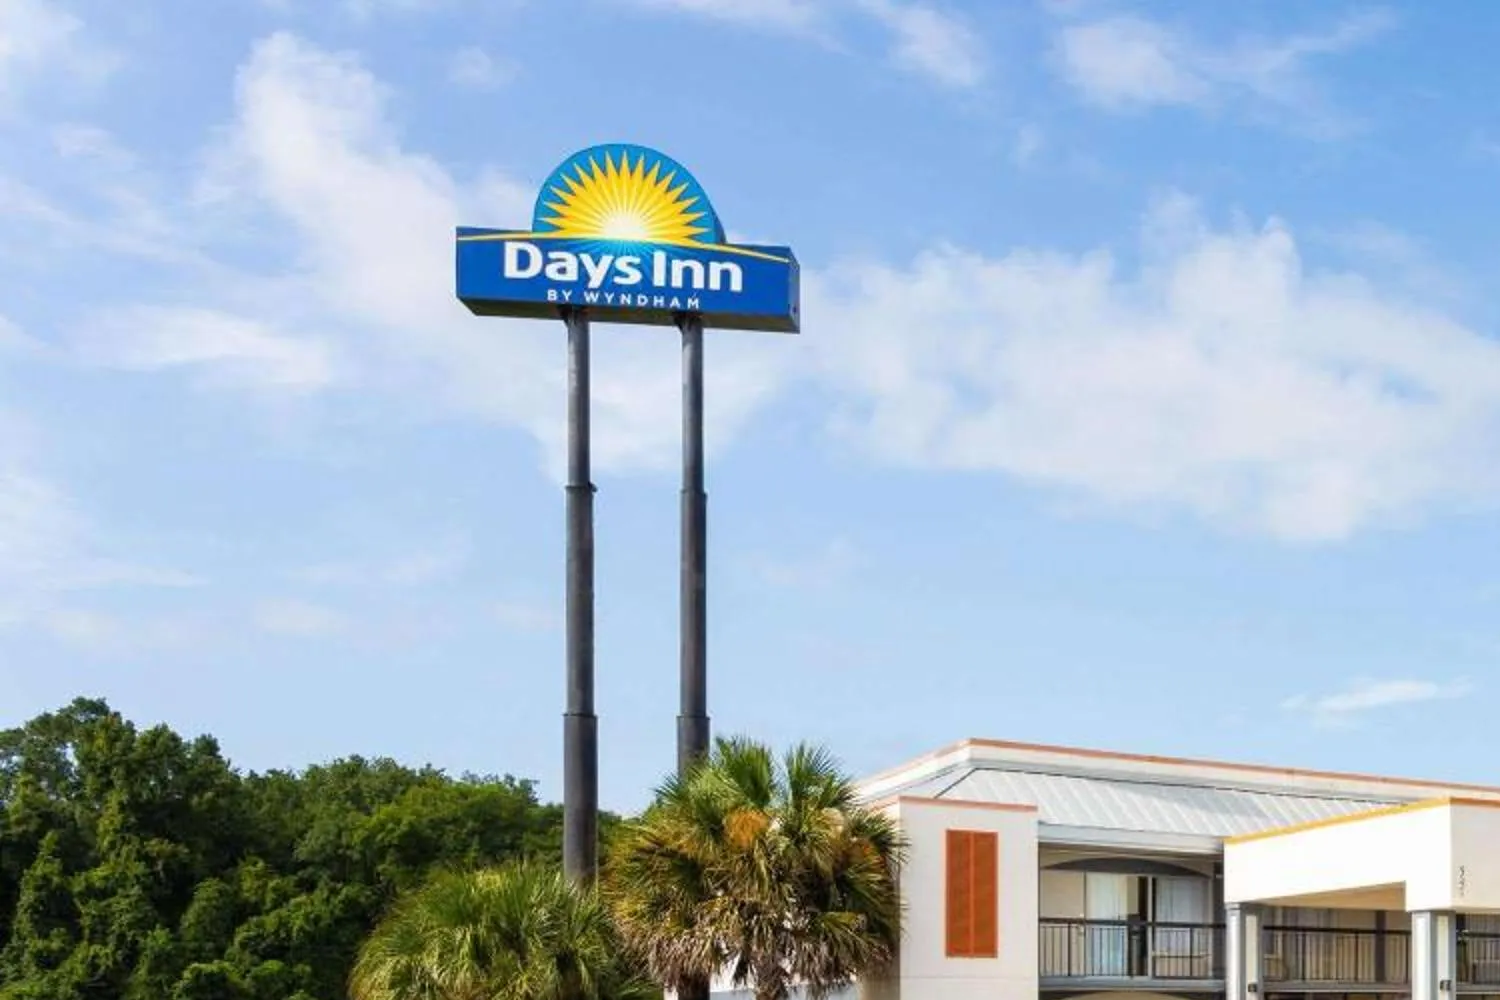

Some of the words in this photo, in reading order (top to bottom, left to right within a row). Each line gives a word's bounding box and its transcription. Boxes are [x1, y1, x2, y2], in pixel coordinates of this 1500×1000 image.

[504, 241, 643, 288] Days
[653, 251, 743, 293] Inn
[547, 290, 572, 303] BY
[584, 291, 701, 309] WYNDHAM
